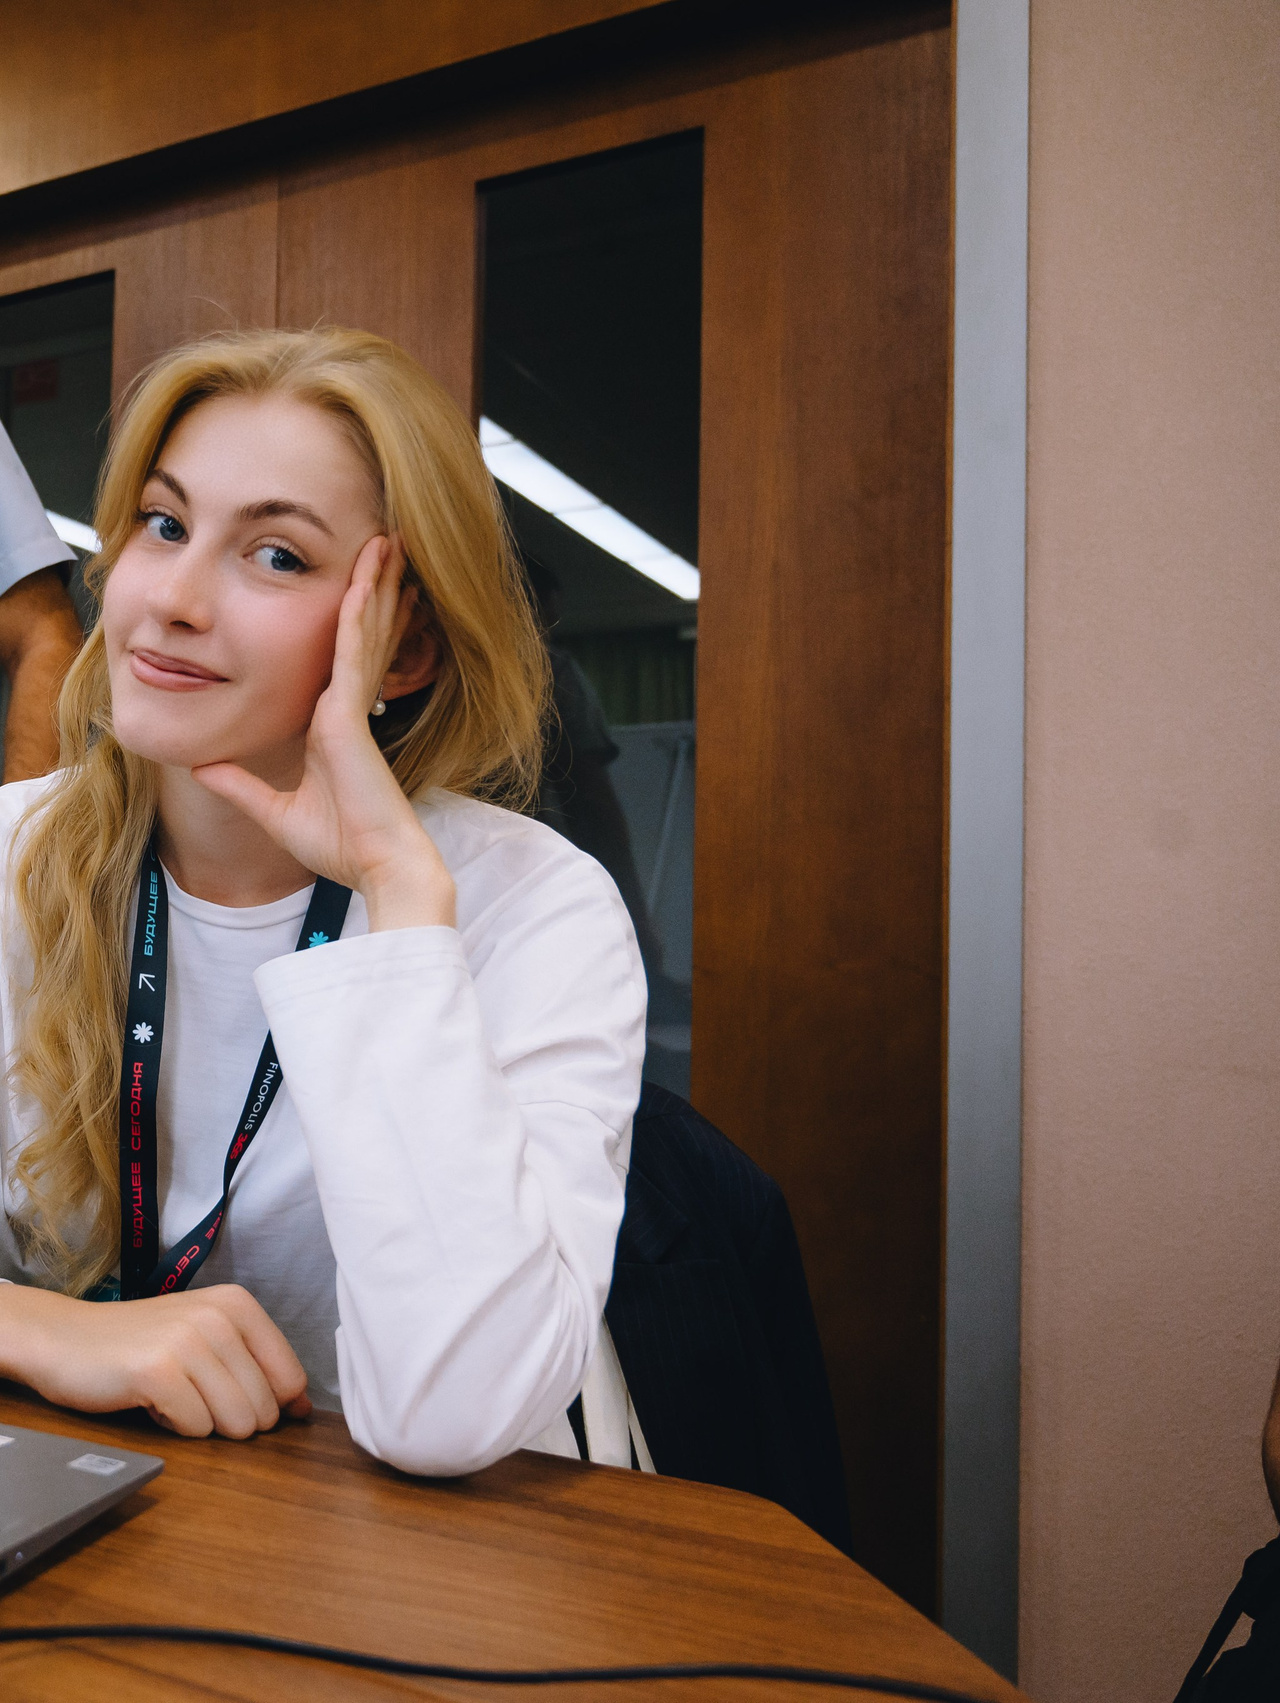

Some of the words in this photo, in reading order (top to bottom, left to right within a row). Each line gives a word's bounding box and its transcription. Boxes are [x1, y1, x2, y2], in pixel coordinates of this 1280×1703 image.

[143, 871, 158, 956] БУДУЩЕЕ
[130, 1062, 143, 1151] СЕГОДНЯ
[244, 1061, 279, 1130] FINOPOLIS
[131, 1162, 143, 1248] БУДУЩЕЕ
